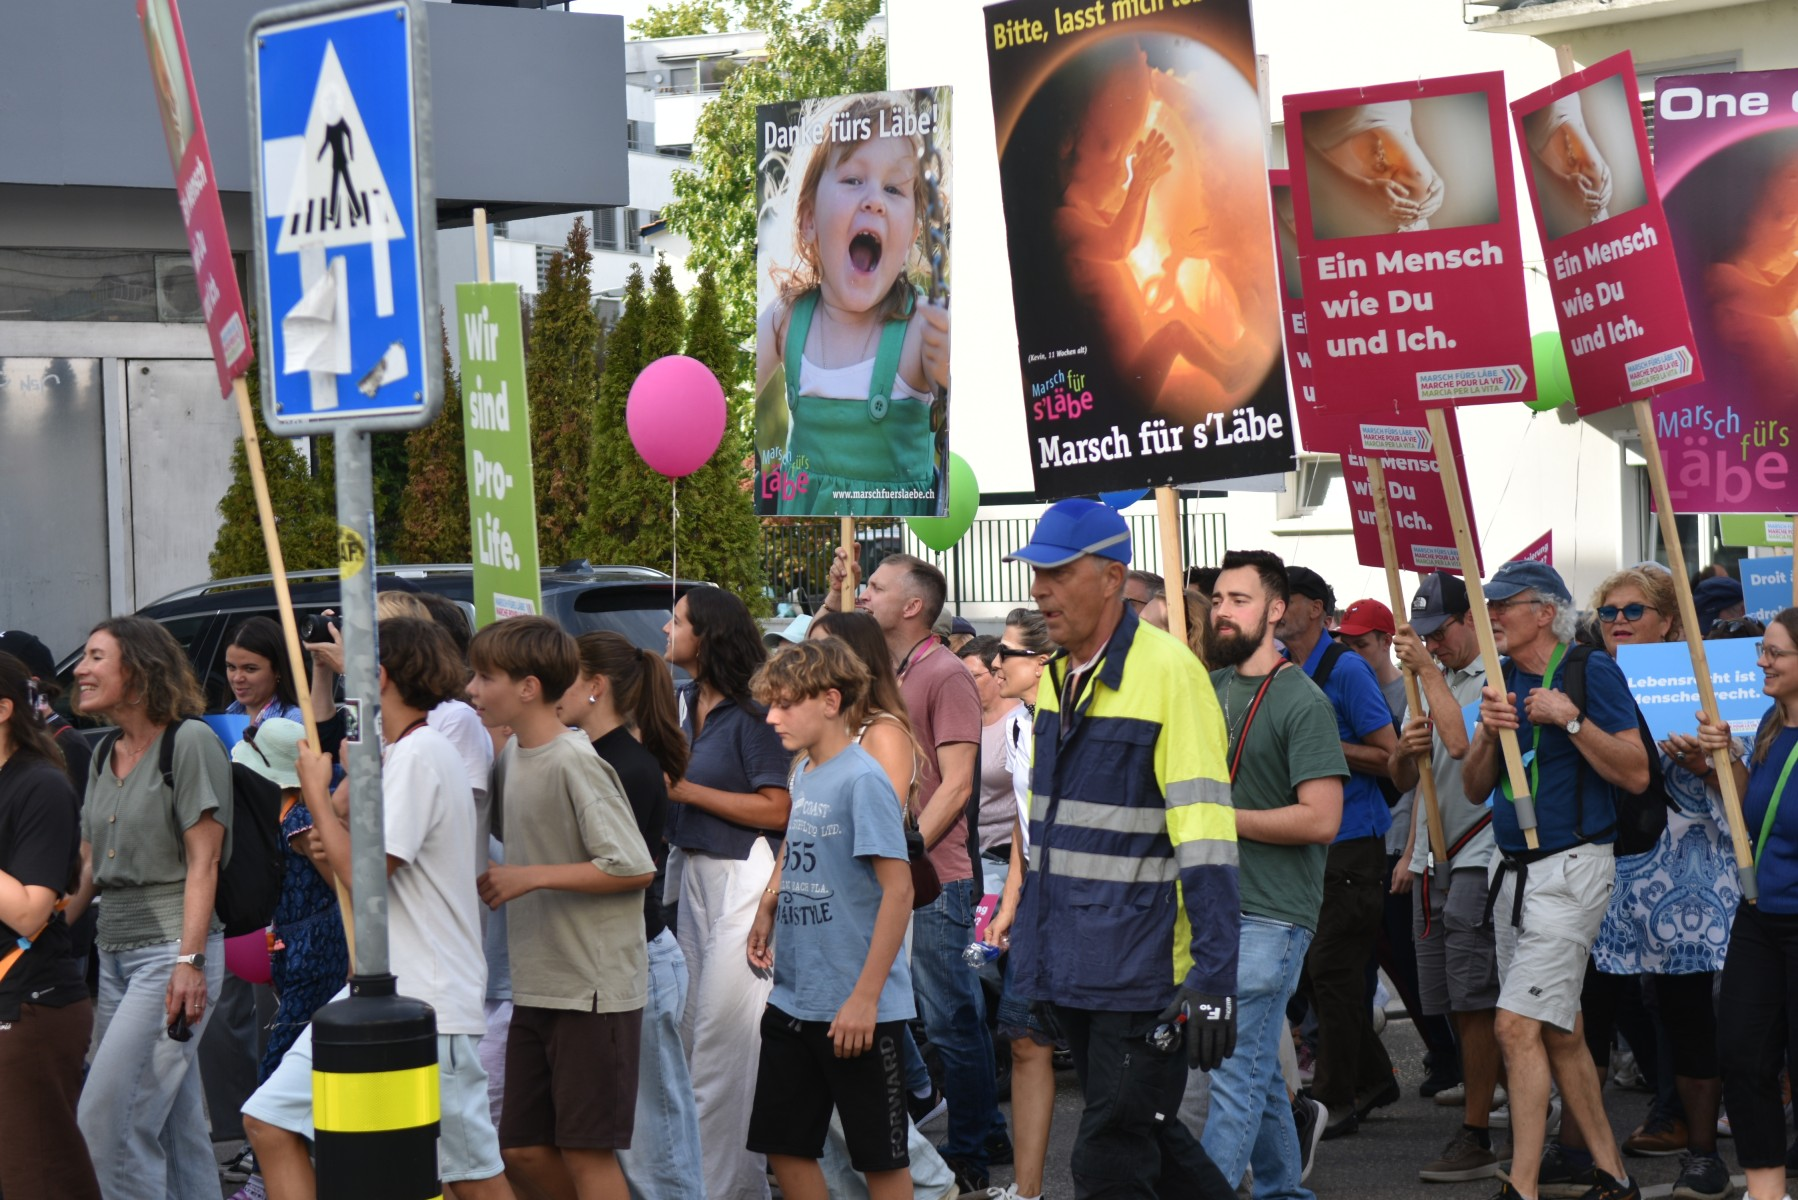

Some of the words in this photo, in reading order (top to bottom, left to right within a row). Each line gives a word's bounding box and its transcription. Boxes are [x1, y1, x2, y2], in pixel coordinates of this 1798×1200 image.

[993, 18, 1049, 50] Bitte,
[1055, 2, 1106, 36] lasst
[1660, 87, 1769, 120] One
[764, 117, 824, 149] Danke
[830, 111, 872, 143] fürs
[879, 103, 938, 138] Läbe!
[1317, 252, 1368, 280] Ein
[1376, 240, 1504, 276] Mensch
[1553, 250, 1583, 281] Ein
[1583, 222, 1658, 270] Mensch
[1321, 290, 1379, 319] wie
[1388, 290, 1434, 314] Du
[1561, 287, 1595, 318] wie
[1595, 280, 1625, 307] Du
[464, 305, 499, 362] Wir
[1326, 329, 1388, 358] und
[1397, 325, 1457, 353] Ich.
[1570, 323, 1606, 357] und
[1607, 314, 1645, 345] Ich.
[1028, 352, 1047, 364] (Kevin,
[1048, 351, 1055, 359] 11
[1056, 348, 1076, 358] Wochen
[1077, 345, 1088, 355] alt)
[1032, 369, 1065, 398] Marsch
[1067, 369, 1085, 392] für
[1420, 373, 1454, 382] MARSCH
[1455, 371, 1476, 380] FÜRS
[1477, 369, 1498, 378] LÄBE
[1421, 380, 1454, 390] MARCHE
[1456, 378, 1478, 388] POUR
[1491, 377, 1504, 385] VIE
[1629, 368, 1650, 380] MARCHE
[1650, 364, 1664, 374] POUR
[469, 374, 510, 432] sind
[1033, 387, 1094, 421] s'Läbe
[1421, 388, 1453, 397] MARCIA
[1453, 387, 1469, 395] PER
[1470, 386, 1479, 394] LA
[1038, 425, 1132, 469] Marsch
[1138, 419, 1184, 456] für
[1193, 406, 1283, 449] s'Läbe
[1658, 405, 1740, 439] Marsch
[1740, 420, 1790, 462] fürs
[473, 449, 513, 500] Pro-
[761, 445, 793, 466] Marsch
[791, 453, 810, 477] fürs
[1381, 457, 1440, 473] Mensc
[1660, 436, 1789, 503] Läbe
[761, 463, 810, 501] Läbe
[832, 488, 936, 500] www.marschfuerslaebe.ch
[1388, 481, 1416, 501] Du
[1396, 511, 1433, 531] Ich.
[477, 511, 521, 572] Life.
[1750, 570, 1787, 586] Droit
[1735, 670, 1756, 683] ist
[880, 1035, 905, 1159] FORWARD
